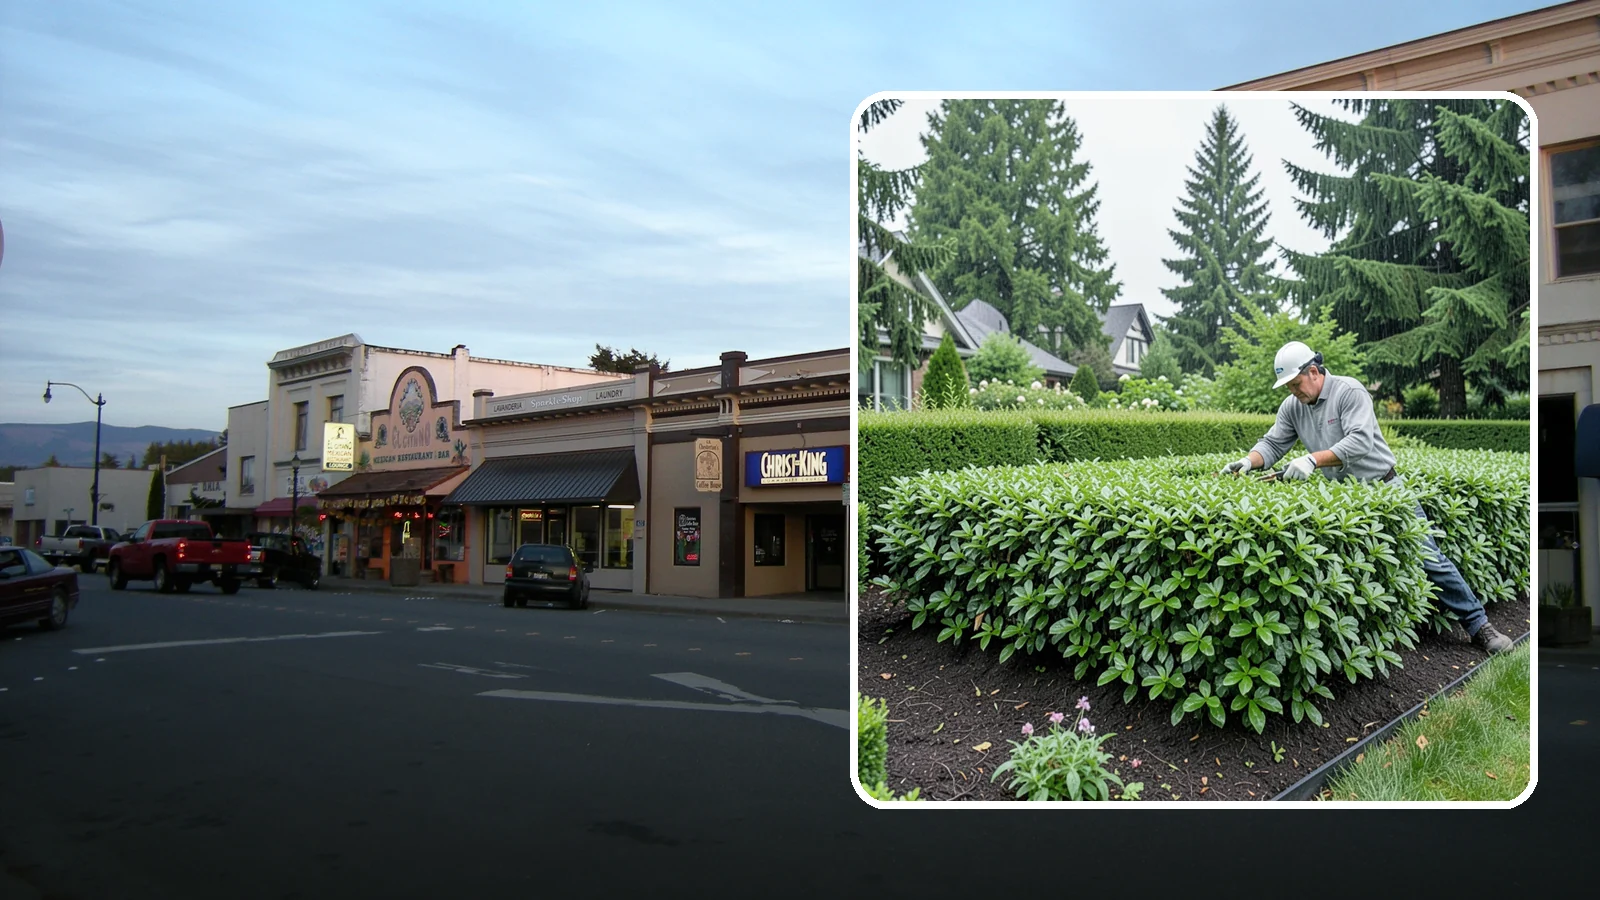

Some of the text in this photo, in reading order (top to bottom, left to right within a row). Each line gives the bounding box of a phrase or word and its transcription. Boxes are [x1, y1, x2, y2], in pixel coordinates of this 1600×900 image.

[494, 402, 522, 412] LAVANDERIA
[561, 394, 582, 404] Shop
[596, 389, 624, 400] LAUNDRY
[398, 452, 433, 462] RESTAURANT
[438, 450, 450, 459] BAR
